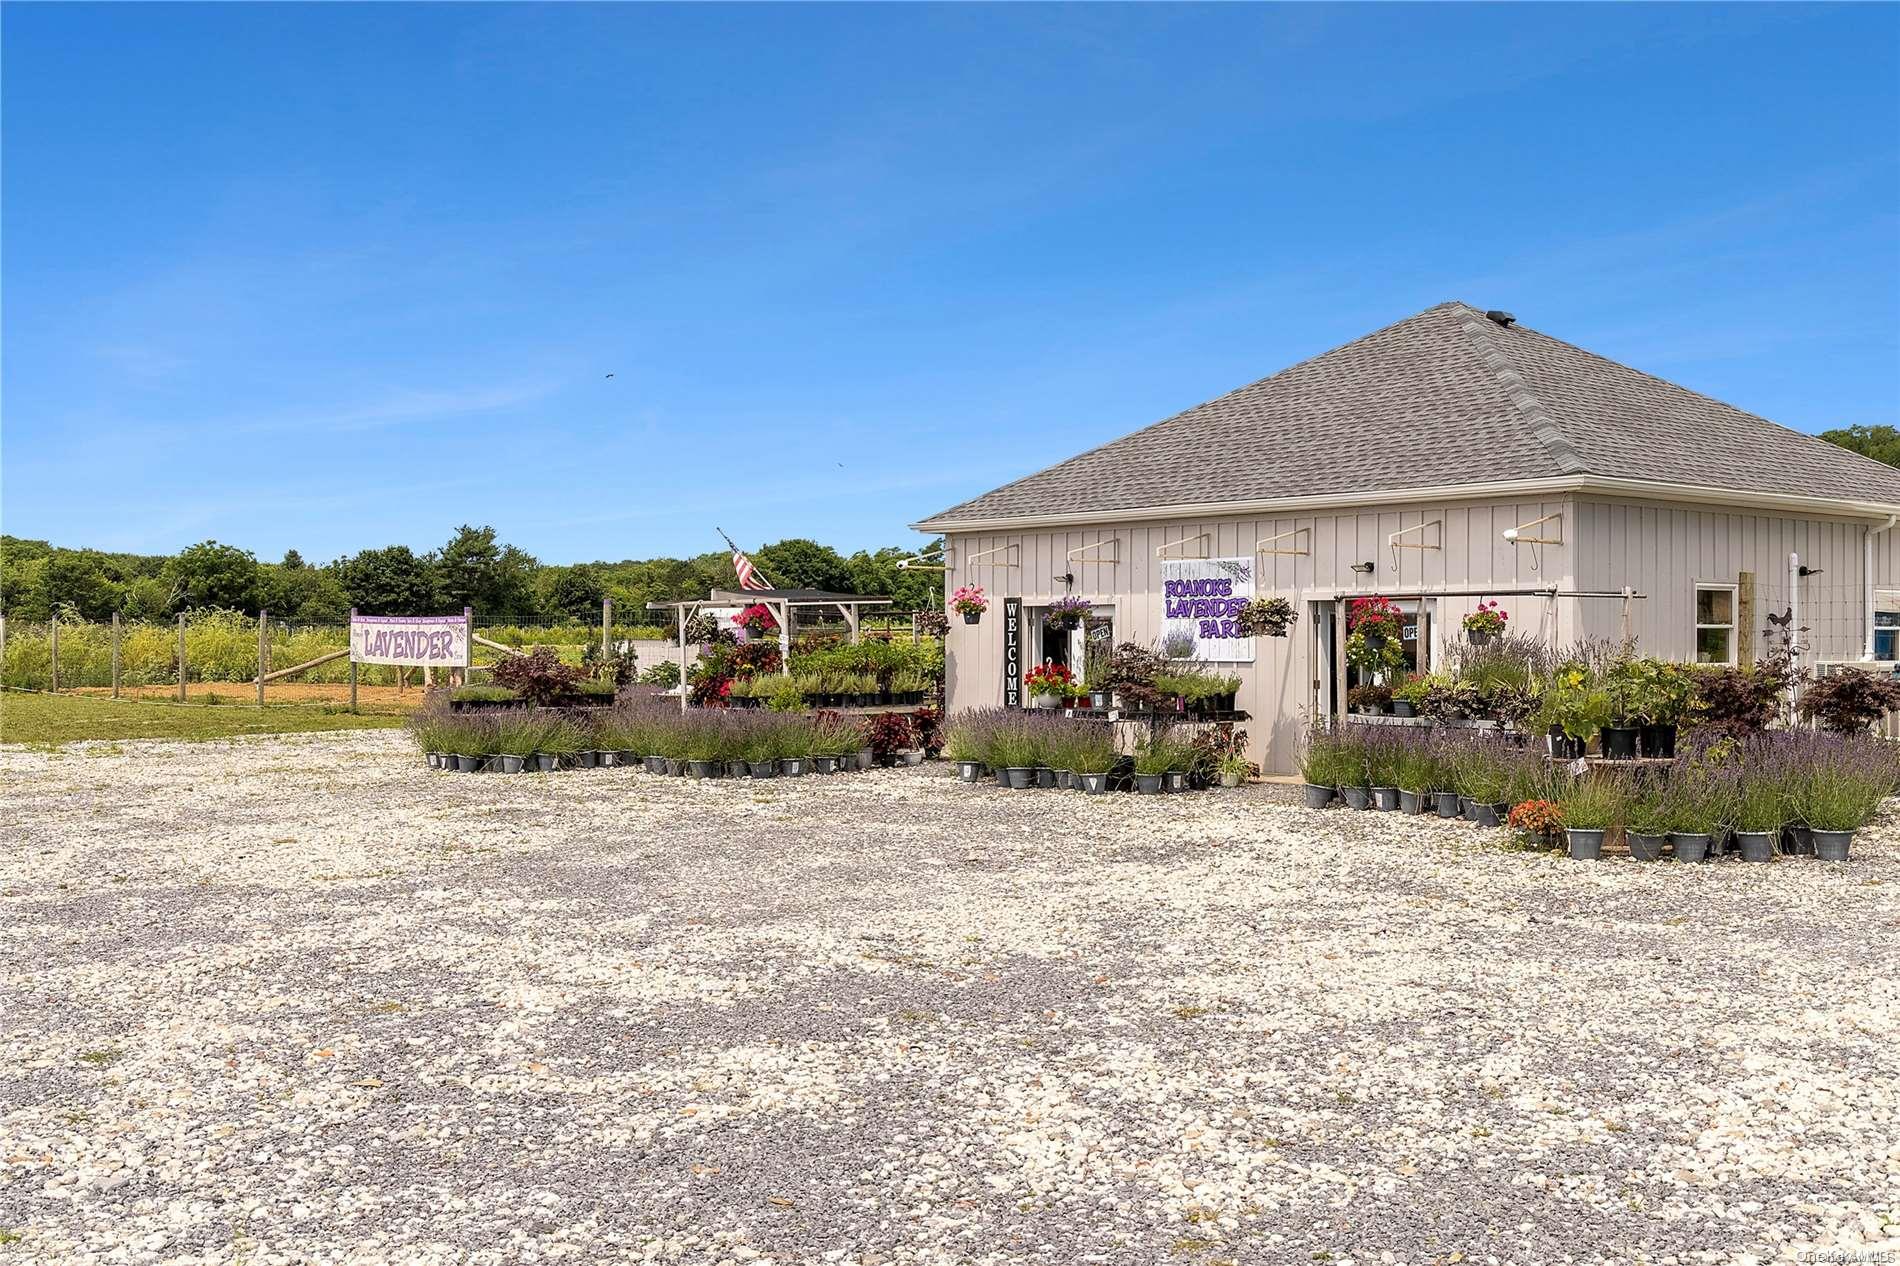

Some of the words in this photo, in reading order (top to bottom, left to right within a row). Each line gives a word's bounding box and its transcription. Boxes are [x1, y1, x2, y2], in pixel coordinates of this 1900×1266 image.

[1165, 579, 1233, 597] ROANOKE
[1092, 627, 1110, 640] OPEN
[1199, 620, 1244, 639] FAR
[364, 629, 454, 660] LAVENDER
[1006, 603, 1018, 706] WELCOME
